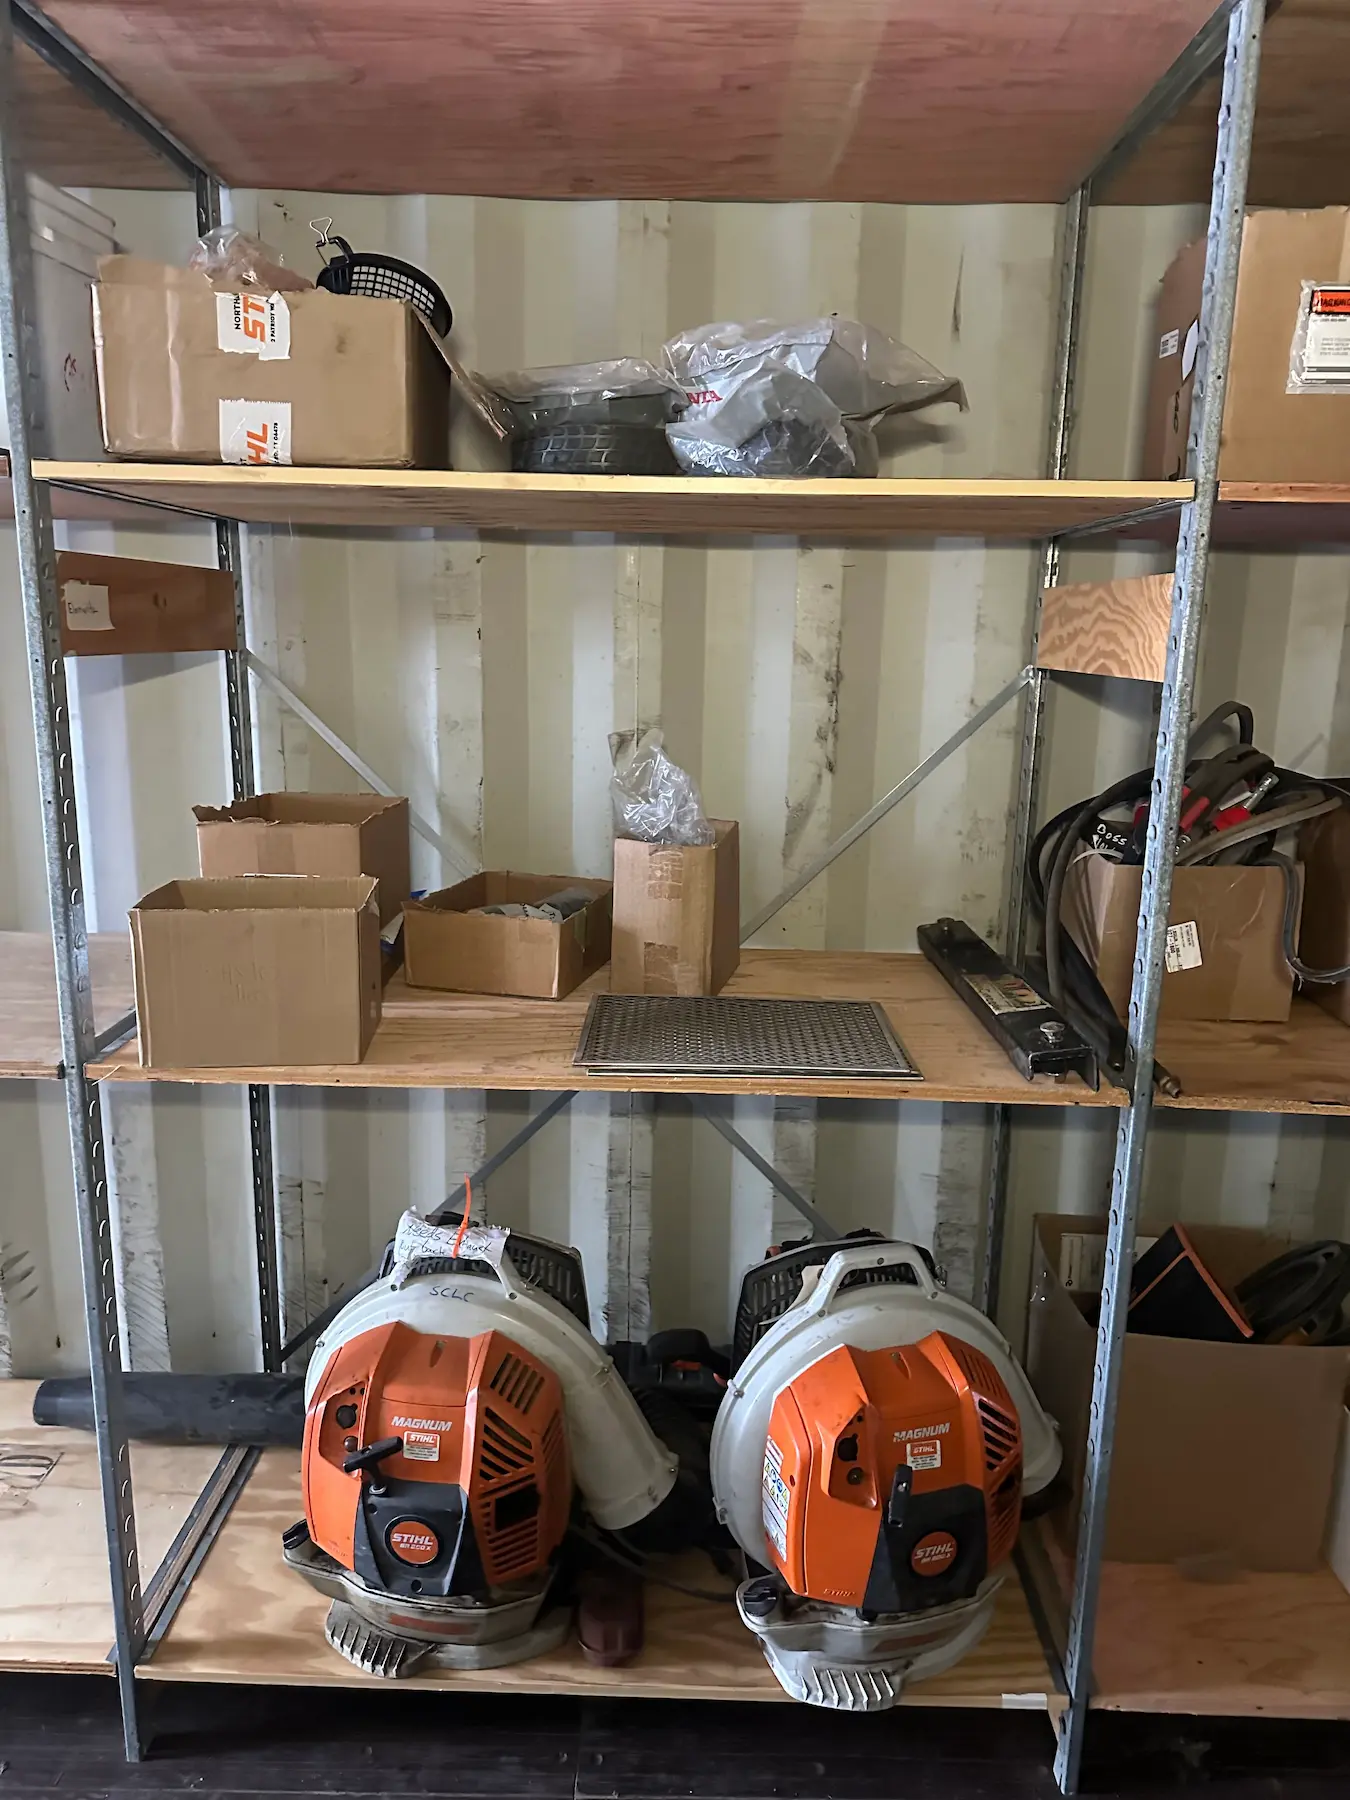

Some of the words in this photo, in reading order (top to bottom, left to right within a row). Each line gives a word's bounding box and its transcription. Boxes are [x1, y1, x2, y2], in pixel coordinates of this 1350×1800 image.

[429, 1285, 475, 1303] SCLC
[391, 1415, 453, 1432] MAGNUM
[409, 1433, 436, 1443] STIHL
[892, 1422, 951, 1443] MAGNUM
[912, 1445, 935, 1454] STIHL
[391, 1532, 434, 1546] STIHL
[913, 1542, 954, 1560] STIHL
